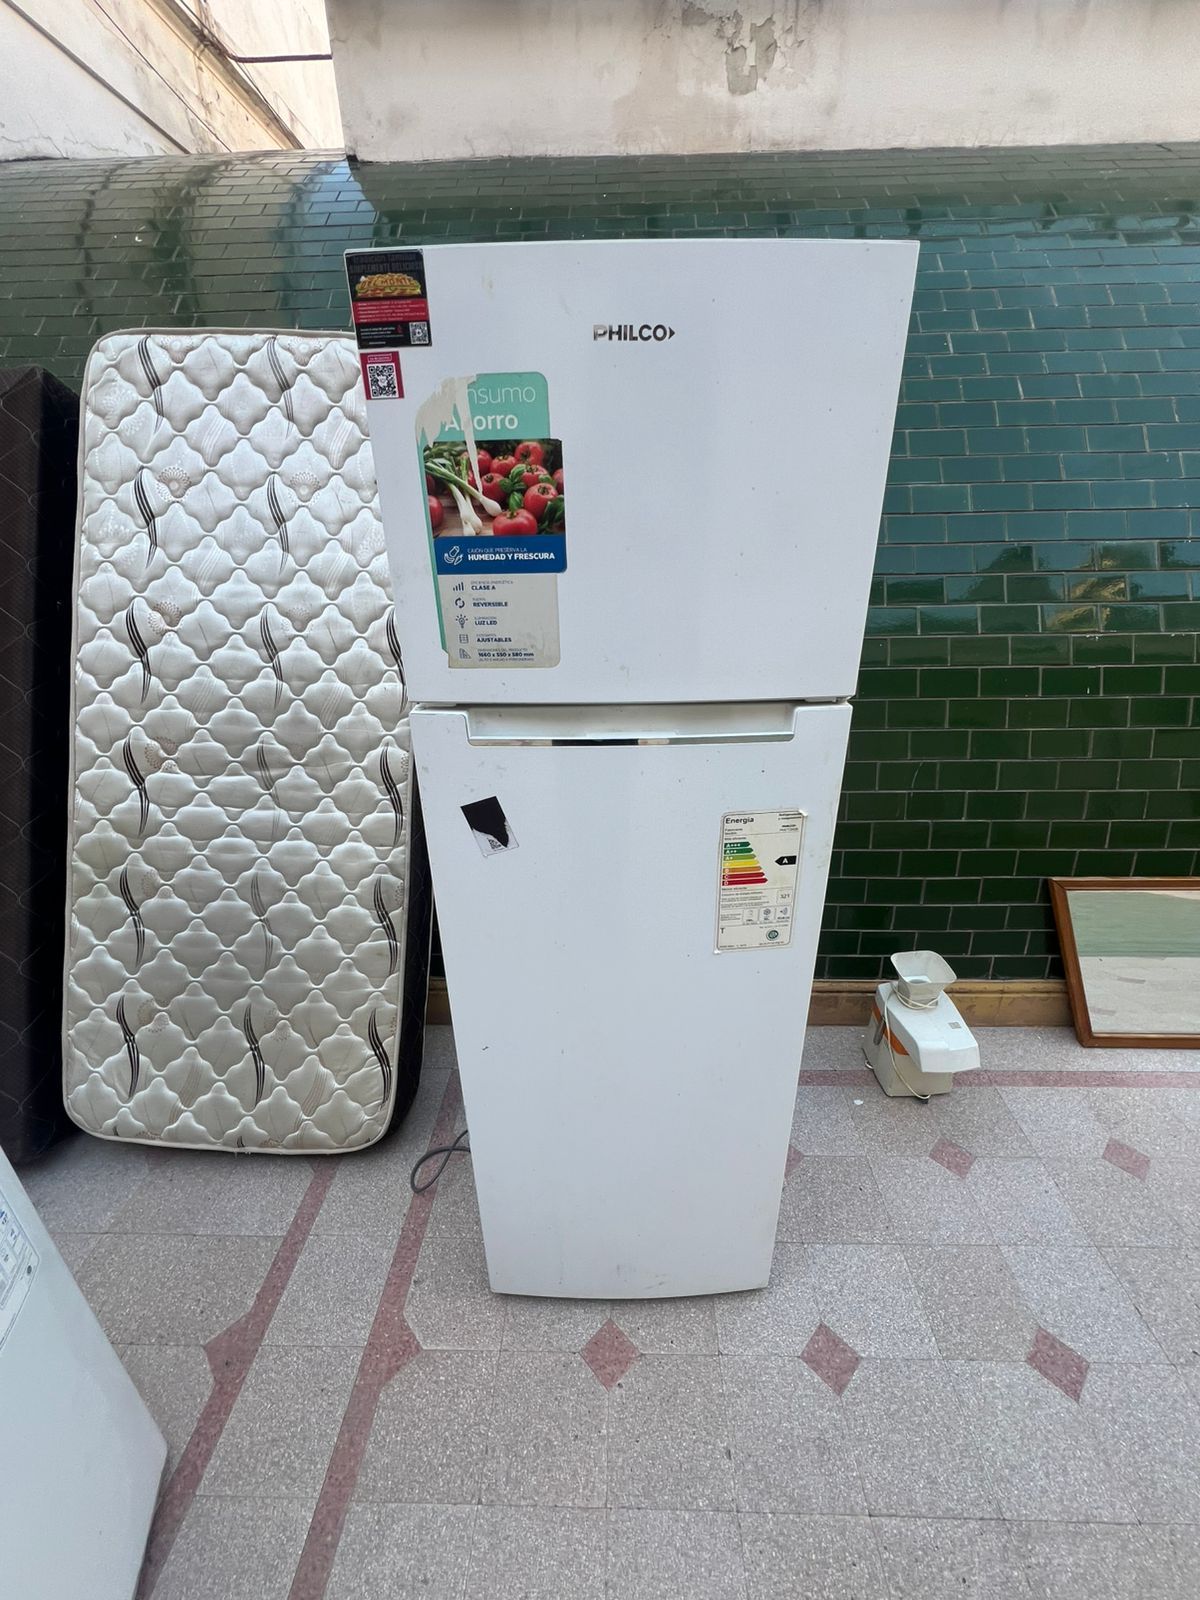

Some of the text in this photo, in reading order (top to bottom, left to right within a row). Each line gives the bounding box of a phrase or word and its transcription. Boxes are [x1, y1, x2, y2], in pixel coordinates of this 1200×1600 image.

[593, 324, 668, 342] PHILCO
[467, 386, 536, 404] nsumo
[445, 414, 518, 431] Aorro
[467, 553, 506, 561] HUMEDAD
[514, 552, 555, 560] FRESCURA
